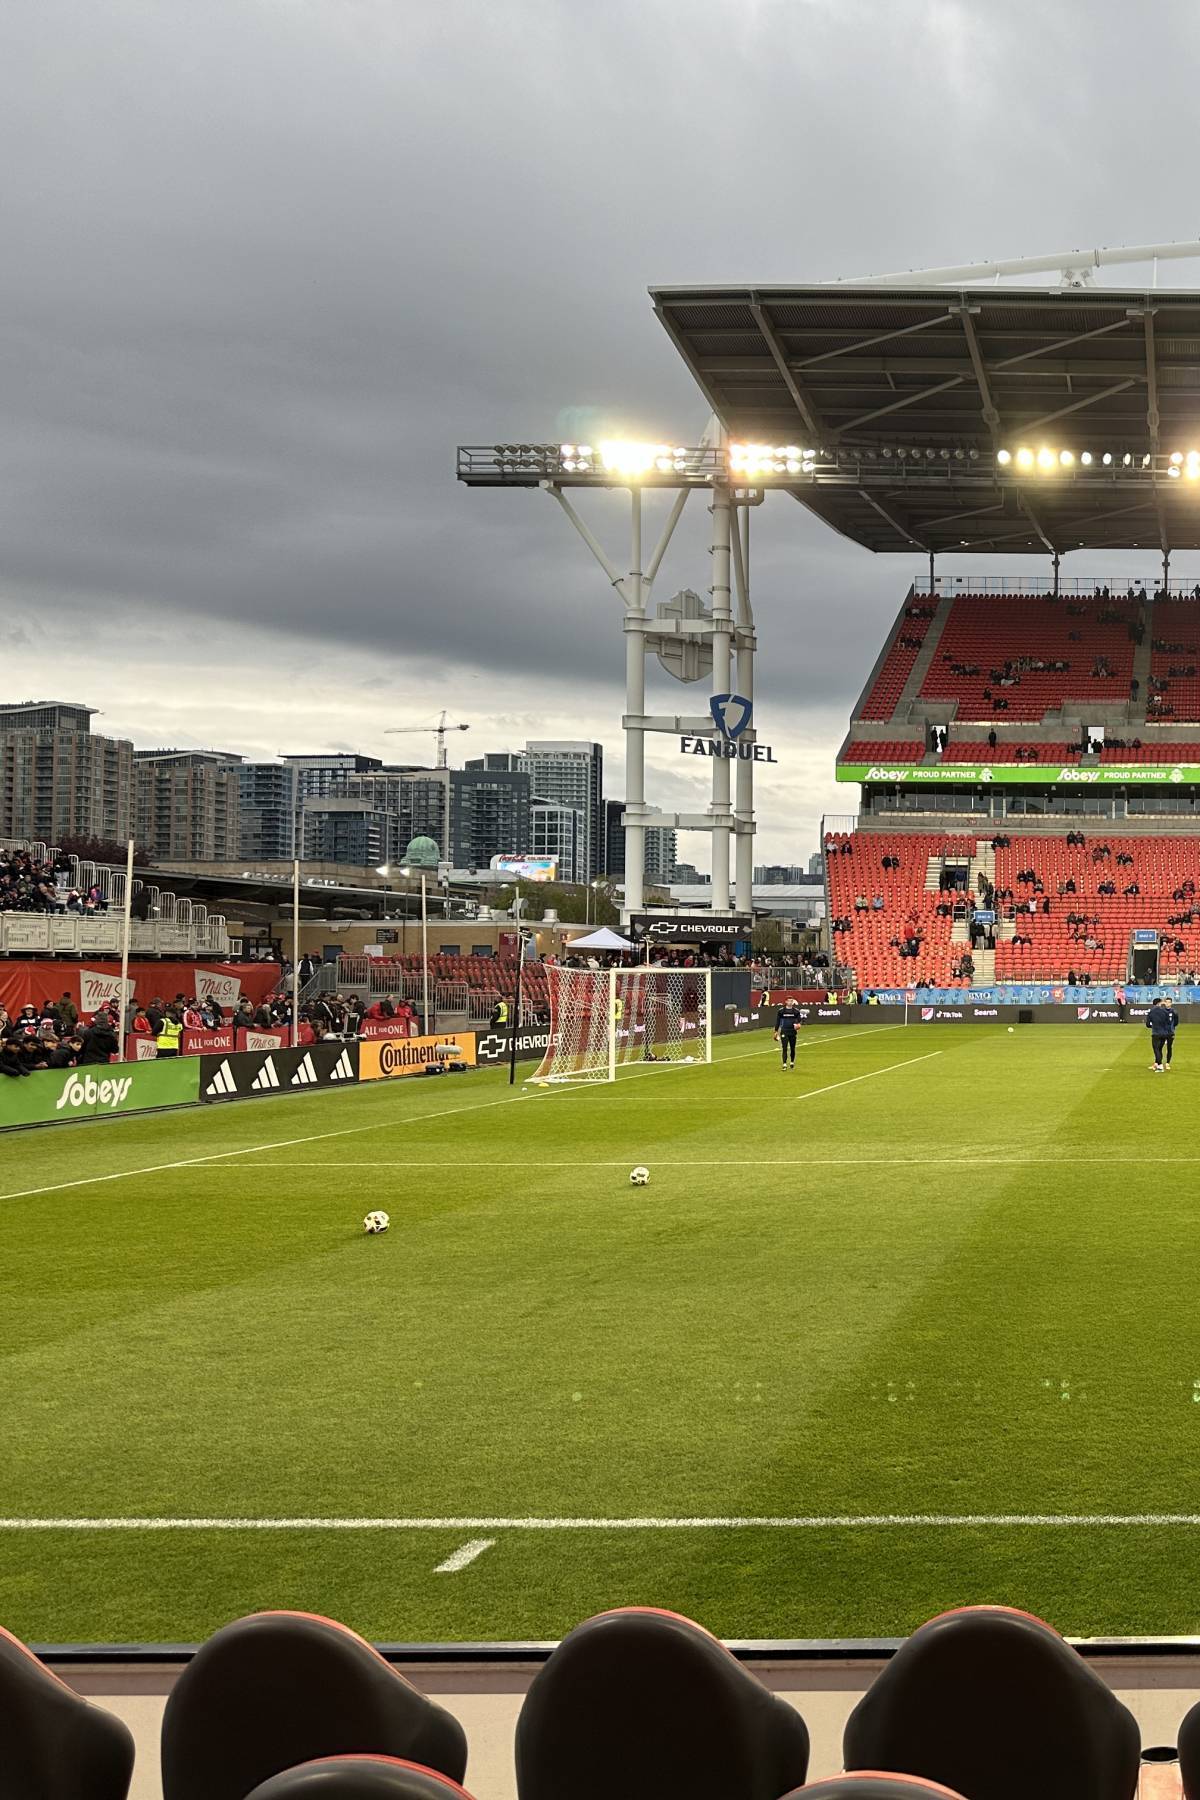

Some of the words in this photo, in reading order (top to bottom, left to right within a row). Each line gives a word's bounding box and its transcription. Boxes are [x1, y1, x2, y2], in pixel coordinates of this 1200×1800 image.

[680, 736, 778, 763] FANDUEL
[864, 767, 909, 781] Sobeys
[913, 770, 938, 779] PROUD
[938, 770, 976, 779] PARTNER
[1057, 767, 1100, 782] Sobeys
[1104, 770, 1129, 779] PROUD
[1129, 770, 1167, 779] PARTNER
[680, 924, 740, 934] CHEVROLET
[85, 980, 113, 998] Mill
[200, 978, 222, 996] Mill
[879, 993, 901, 1001] BMO
[968, 992, 991, 1000] BMO
[817, 1008, 841, 1017] Search
[974, 1008, 998, 1017] Search
[364, 1025, 378, 1036] ALL
[388, 1024, 404, 1035] ONE
[188, 1037, 203, 1050] ALL
[214, 1036, 231, 1048] ONE
[56, 1072, 133, 1110] Sobeys
